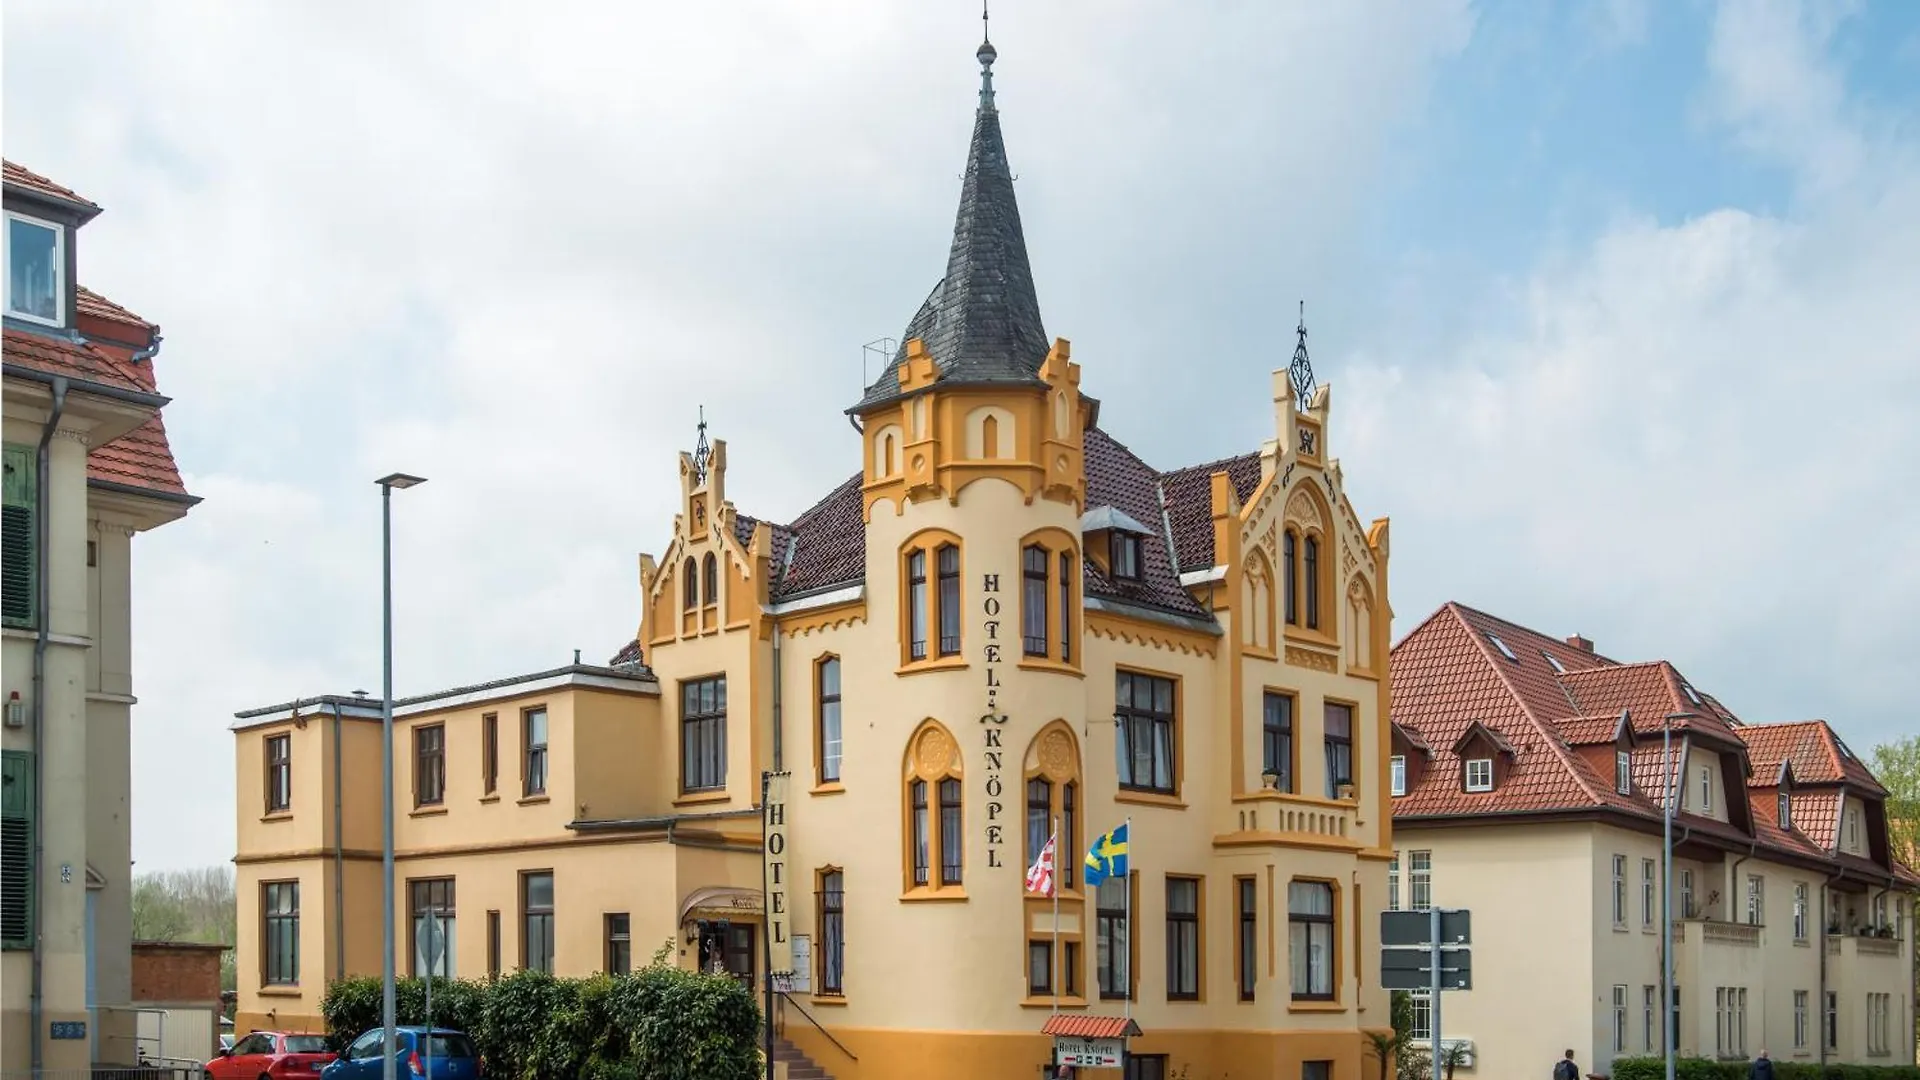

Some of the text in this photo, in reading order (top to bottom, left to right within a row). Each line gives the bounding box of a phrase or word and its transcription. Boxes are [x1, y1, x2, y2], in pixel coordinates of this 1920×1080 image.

[983, 574, 1003, 867] HOTEL KNÖPEL
[769, 804, 785, 943] HOTEL
